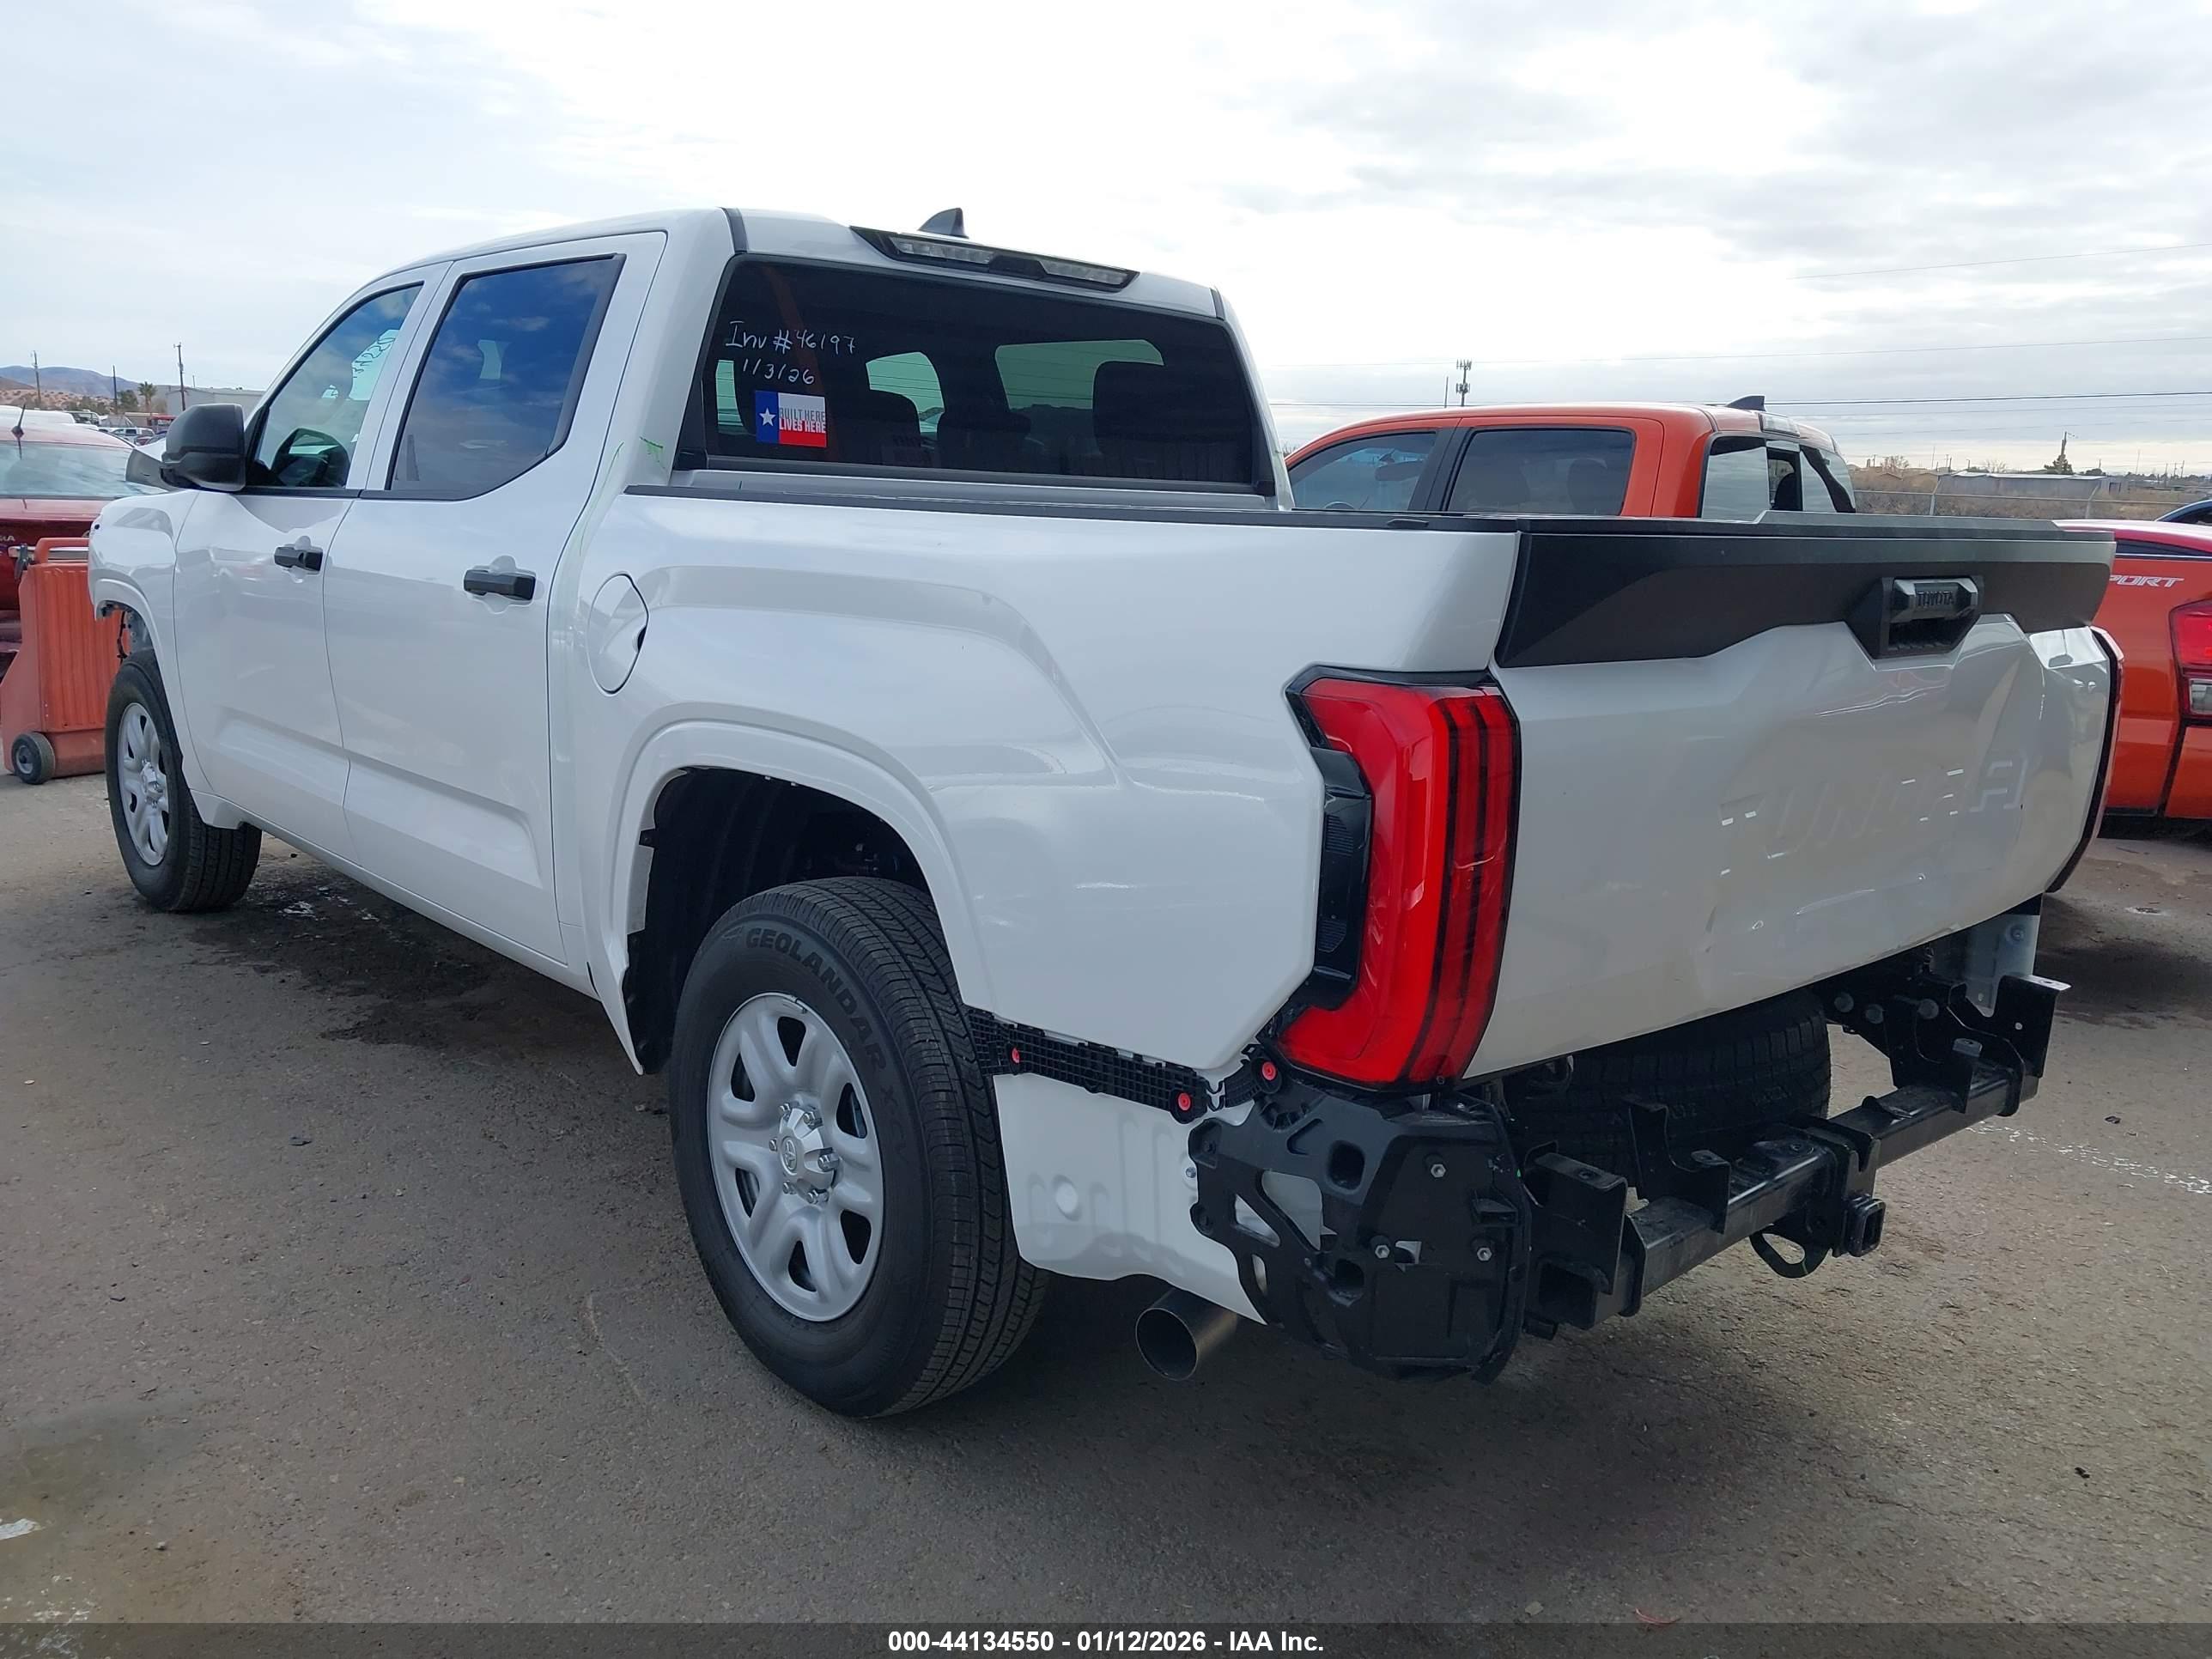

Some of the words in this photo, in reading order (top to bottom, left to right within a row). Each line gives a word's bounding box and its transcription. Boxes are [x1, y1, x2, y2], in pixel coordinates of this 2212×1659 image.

[726, 321, 767, 349] Inv
[742, 357, 816, 385] 1/3/26
[779, 407, 803, 420] BUILT
[805, 410, 825, 422] HERE
[779, 418, 803, 432] LIVES
[805, 420, 826, 434] HERE
[2109, 574, 2185, 587] PORT
[745, 927, 888, 1071] GEOLANDAR
